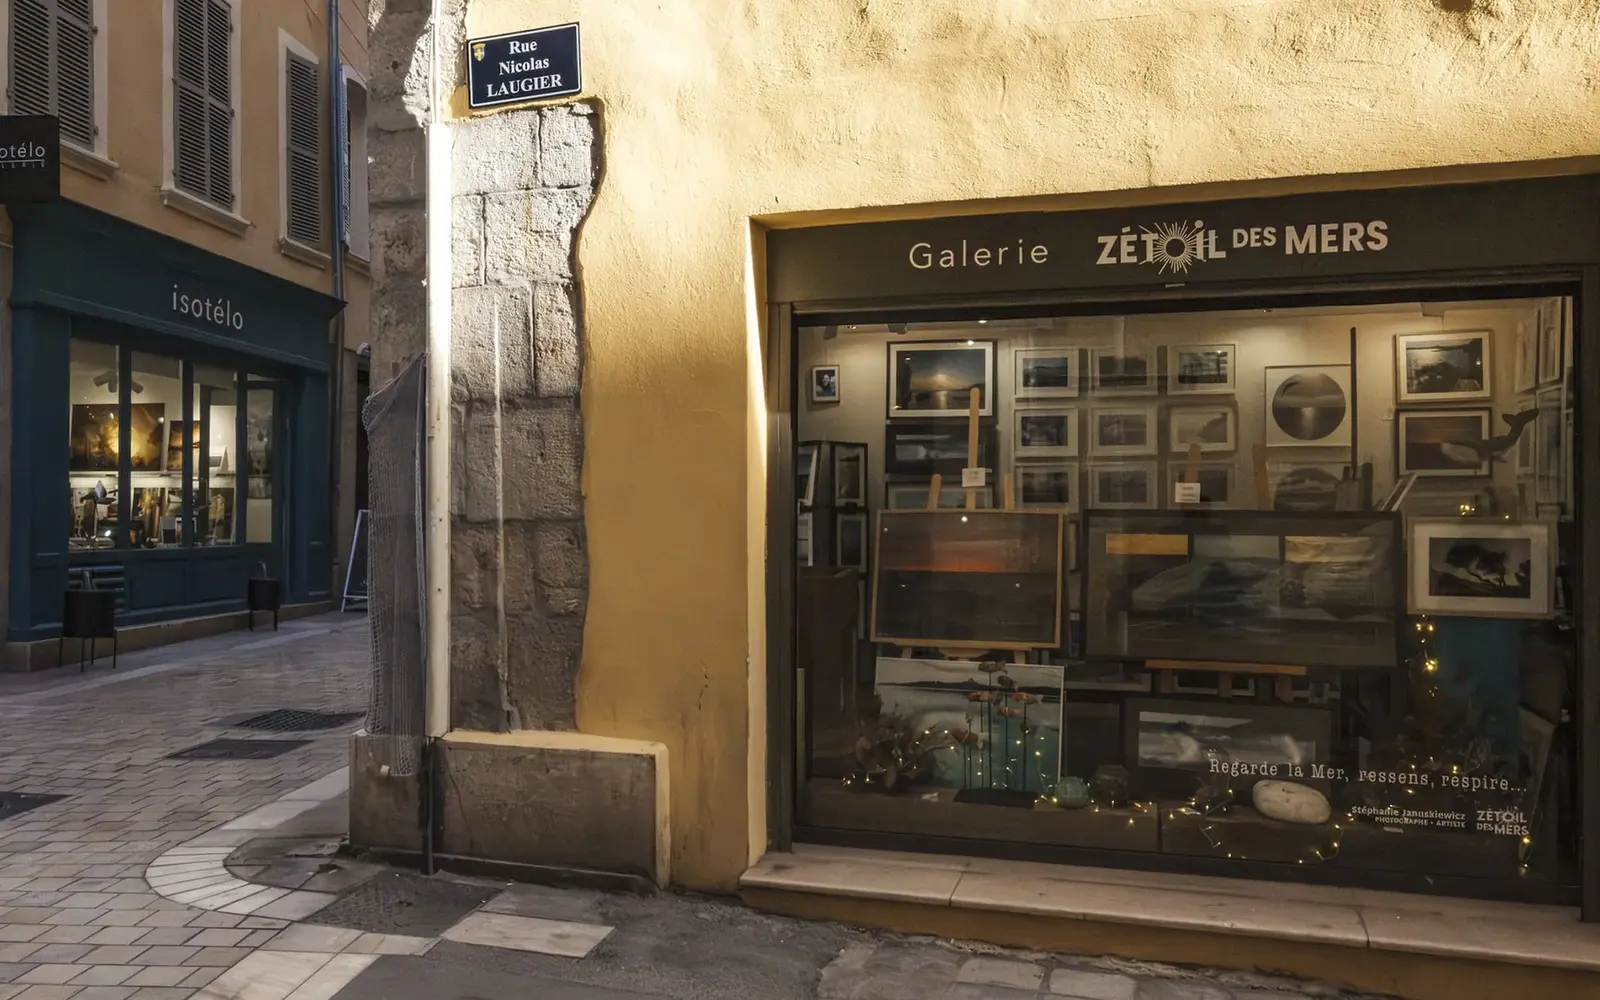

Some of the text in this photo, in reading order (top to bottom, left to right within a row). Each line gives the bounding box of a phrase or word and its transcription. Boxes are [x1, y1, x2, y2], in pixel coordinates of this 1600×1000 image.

[509, 40, 538, 55] Rue
[499, 57, 550, 75] Nicolas
[486, 73, 563, 97] LAUGIER
[909, 239, 1049, 269] Galerie
[1232, 226, 1277, 249] DES
[1284, 220, 1389, 255] MERS
[172, 284, 243, 330] isotélo
[1209, 758, 1278, 777] Regarde
[1288, 762, 1304, 778] la
[1311, 764, 1349, 782] Mer,
[1359, 770, 1435, 789] ressens,
[1351, 805, 1466, 820] Stéphanie Januskiewicz
[1375, 816, 1428, 826] PHOTOGRAPHE
[1476, 822, 1530, 836] DES MERS
